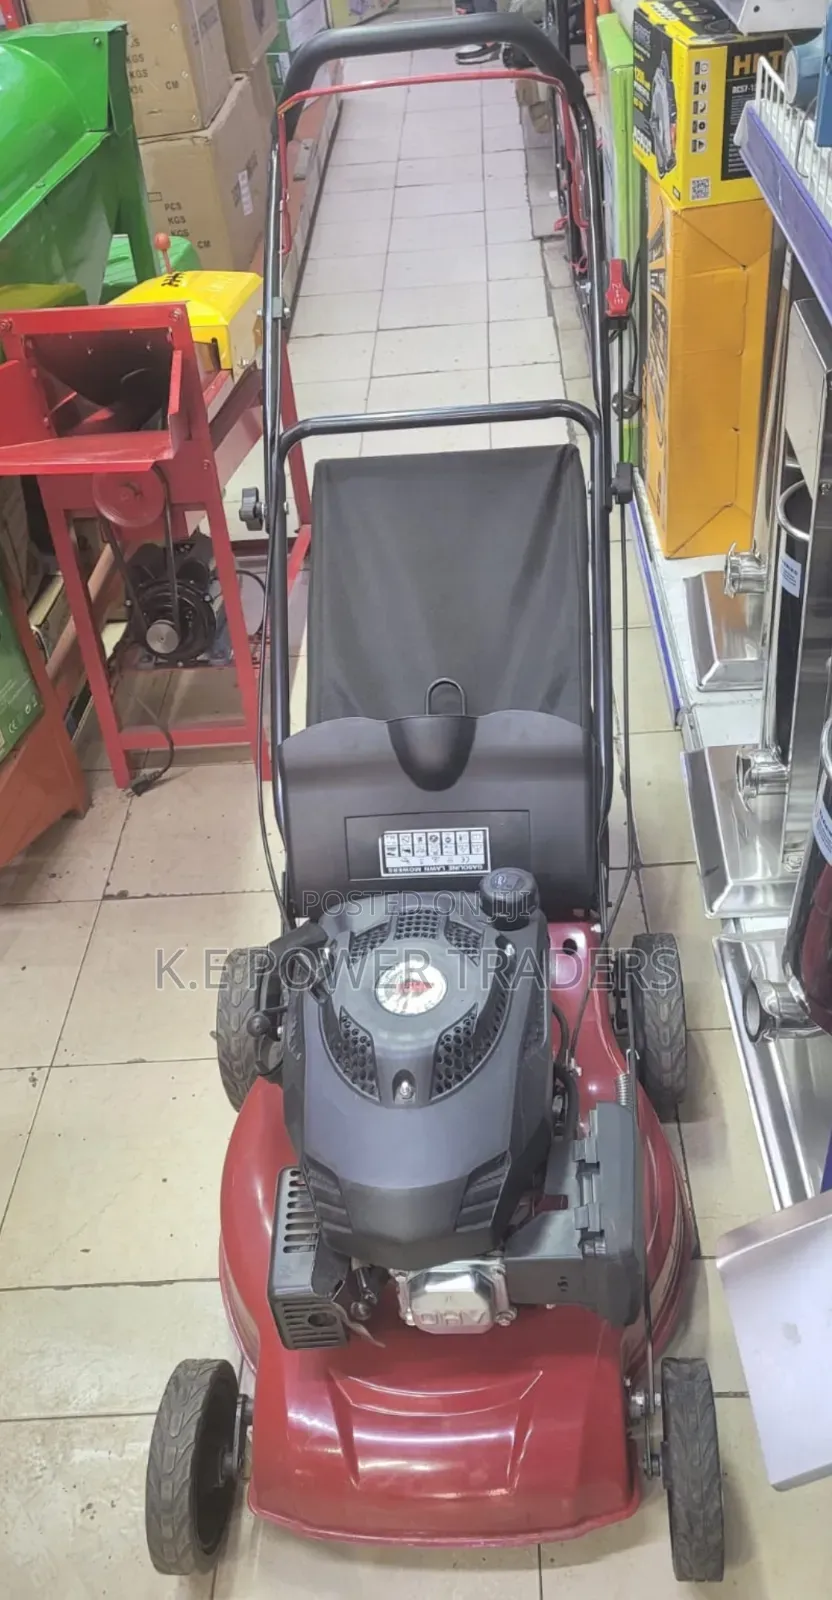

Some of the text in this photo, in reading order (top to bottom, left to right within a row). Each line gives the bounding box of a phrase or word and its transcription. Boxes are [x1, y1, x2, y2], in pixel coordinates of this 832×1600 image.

[164, 202, 182, 211] PCS
[168, 216, 187, 225] KGS
[197, 240, 211, 249] CM
